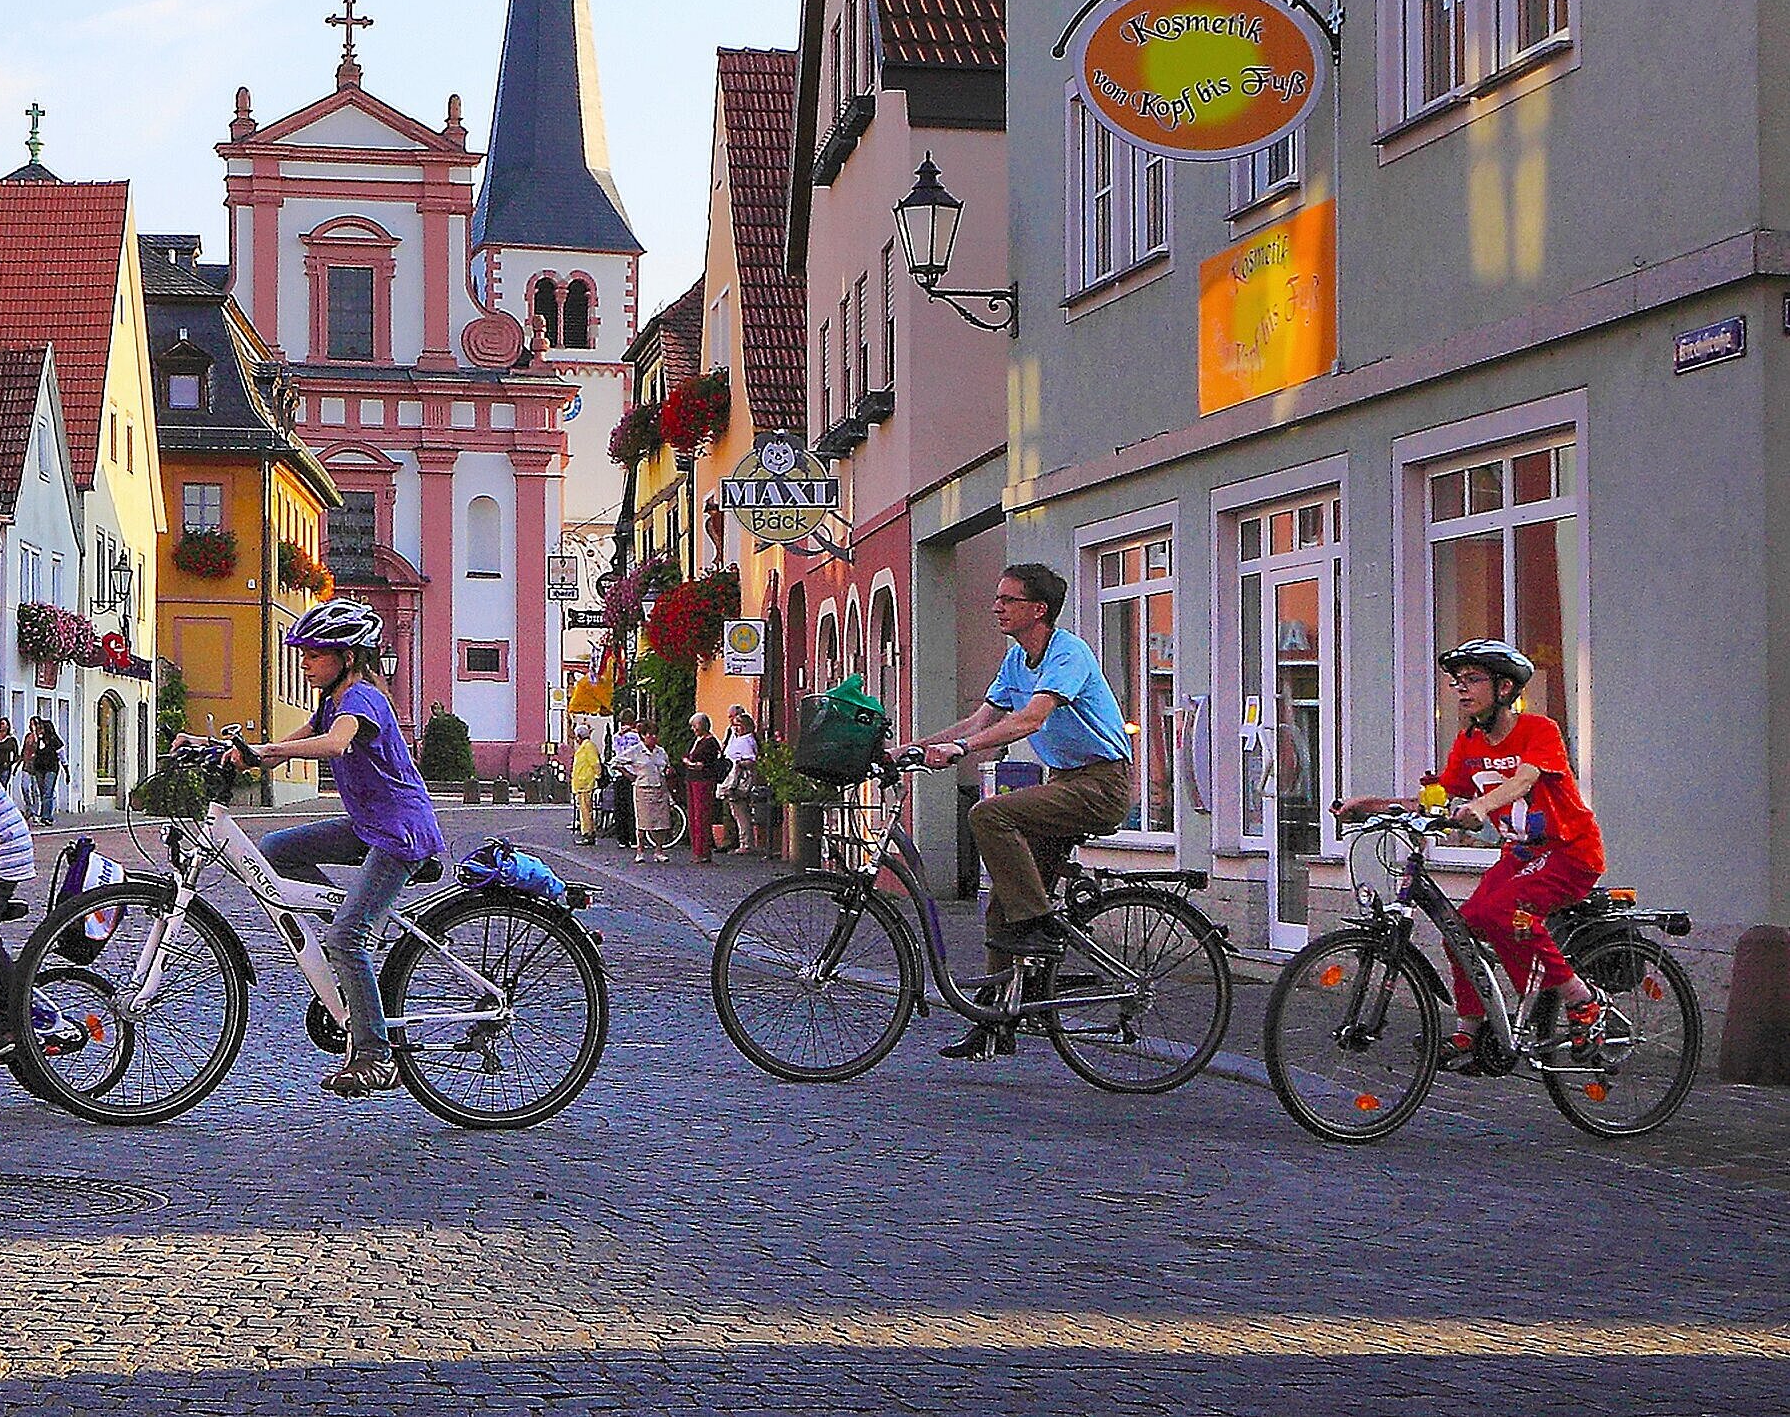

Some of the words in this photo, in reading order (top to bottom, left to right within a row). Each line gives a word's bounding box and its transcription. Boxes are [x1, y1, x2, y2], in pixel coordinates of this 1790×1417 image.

[1121, 11, 1263, 46] Kosmetik
[1093, 69, 1127, 106] von
[1131, 88, 1195, 130] Kopf
[1195, 77, 1232, 103] bis
[1240, 65, 1307, 102] Fuß
[724, 481, 838, 506] MAXL
[752, 510, 809, 531] Bäck
